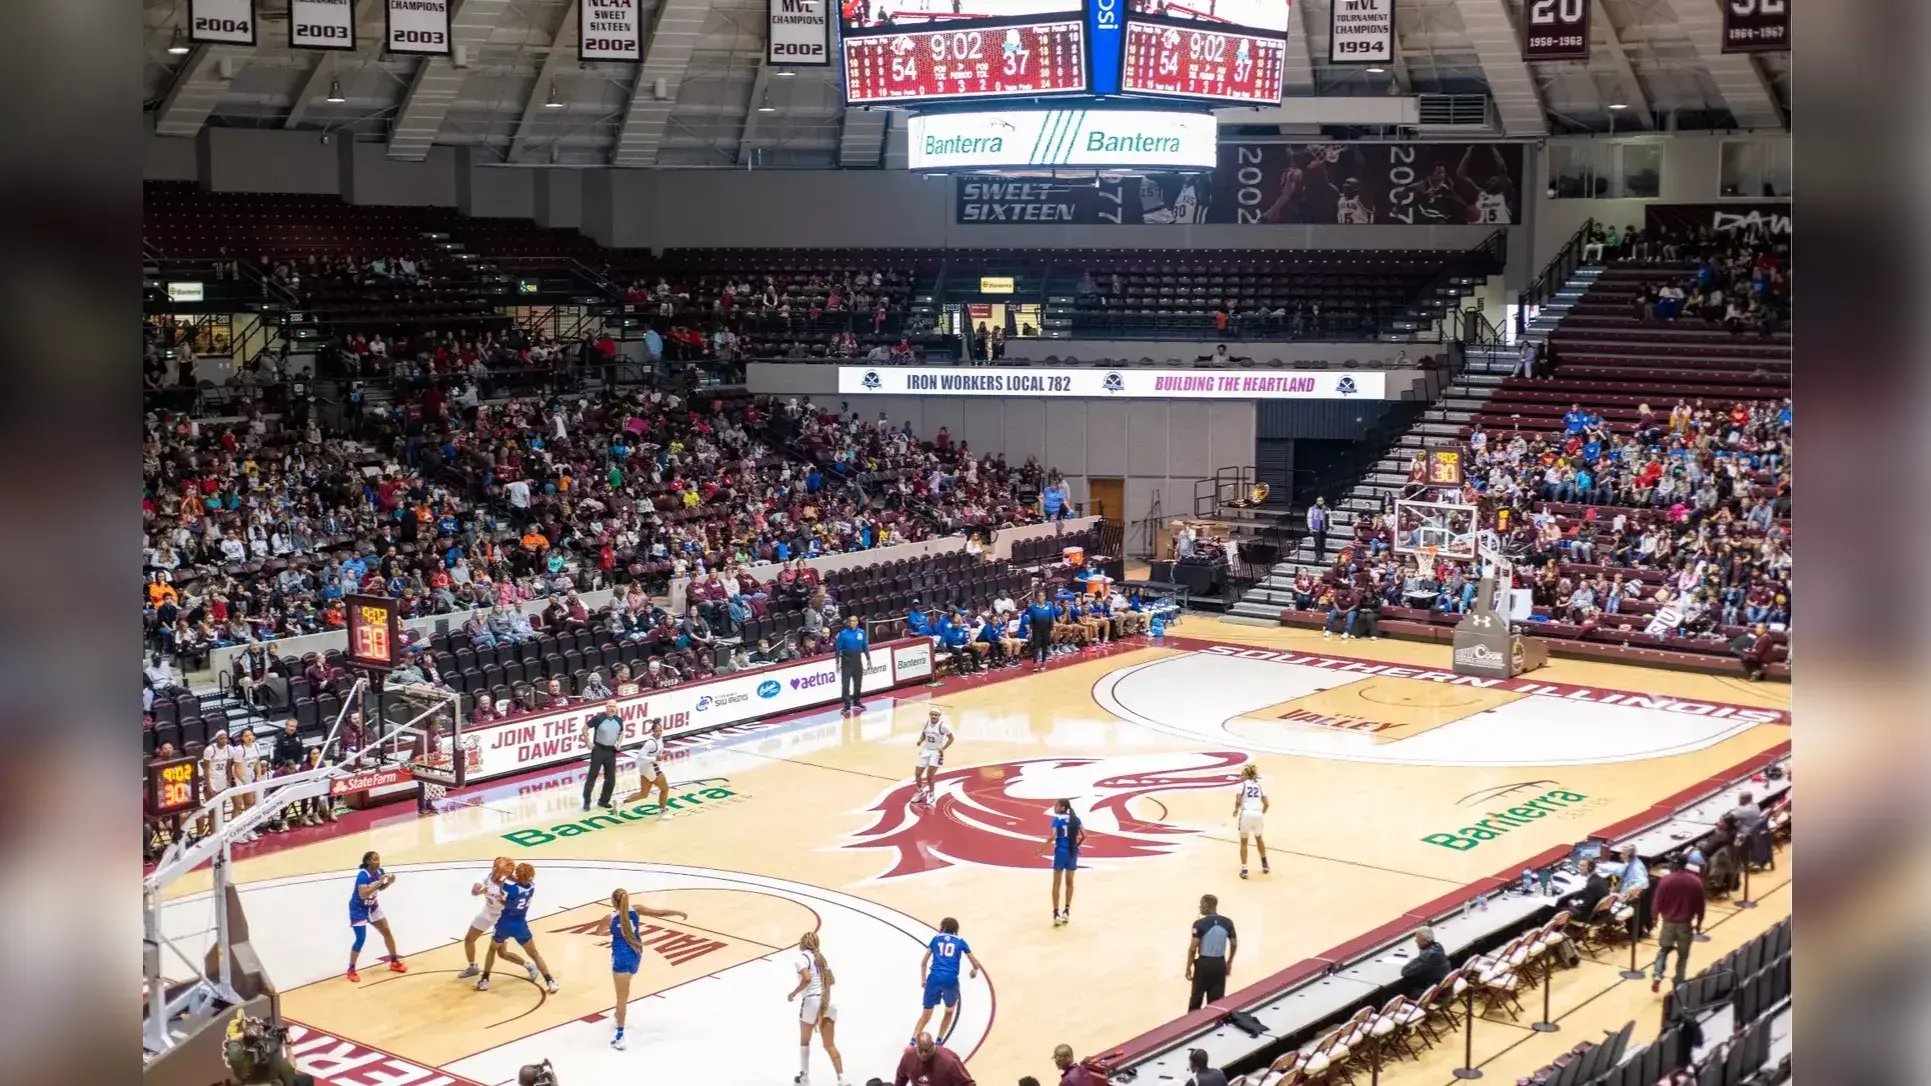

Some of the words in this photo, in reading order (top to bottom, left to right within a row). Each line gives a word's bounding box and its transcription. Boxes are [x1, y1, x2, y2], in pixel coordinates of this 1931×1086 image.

[391, 0, 445, 11] CHAMPIONS
[1346, 0, 1378, 10] MVL
[1532, 0, 1582, 23] 20
[593, 10, 625, 20] SWEET
[772, 15, 824, 25] CHAMPIONS
[1337, 14, 1388, 22] TOURNAMENT
[196, 17, 249, 34] 2004
[296, 24, 348, 39] 2003
[590, 22, 630, 32] SIXTEEN
[1335, 25, 1388, 34] CHAMPIONS
[394, 30, 445, 44] 2003
[584, 39, 635, 51] 2002
[774, 43, 823, 55] 2002
[931, 32, 983, 60] 9:02
[1190, 33, 1225, 62] 9:02
[1339, 41, 1384, 53] 1994
[892, 57, 917, 81] 54
[1003, 50, 1030, 76] 37
[1159, 51, 1178, 76] 54
[1234, 60, 1253, 82] 37
[937, 81, 944, 93] 3
[958, 80, 966, 93] 3
[980, 79, 986, 91] 2
[925, 135, 1003, 155] Banterra
[1086, 131, 1180, 152] Banterra
[963, 183, 1053, 200] SWEET
[1238, 147, 1262, 223] 2002
[1389, 147, 1414, 224] 2007
[963, 204, 1075, 220] SIXTEEN
[907, 374, 937, 390] IRON
[940, 375, 1003, 391] WORKERS
[1007, 376, 1045, 391] LOCAL
[1048, 376, 1071, 391] 782
[1155, 376, 1215, 391] BUILDING
[1218, 376, 1241, 391] THE
[1243, 377, 1316, 392] HEARTLAND
[362, 606, 388, 627] 9:02
[898, 657, 927, 670] Banterra
[801, 671, 836, 689] aetna
[1207, 645, 1505, 689] SOUTHERN
[1514, 684, 1783, 723] ILLINOIS
[642, 711, 690, 733] CUB!
[491, 725, 534, 749] JOIN
[543, 716, 579, 738] THE
[927, 735, 936, 743] 23
[518, 733, 589, 762] DAWG'S
[163, 763, 192, 782] 9:02
[348, 776, 372, 791] State
[373, 773, 397, 786] Farm
[165, 783, 185, 806] 30
[1247, 786, 1259, 798] 22
[500, 786, 739, 848] Banterra
[1420, 789, 1588, 851] Banterra
[938, 942, 956, 957] 10
